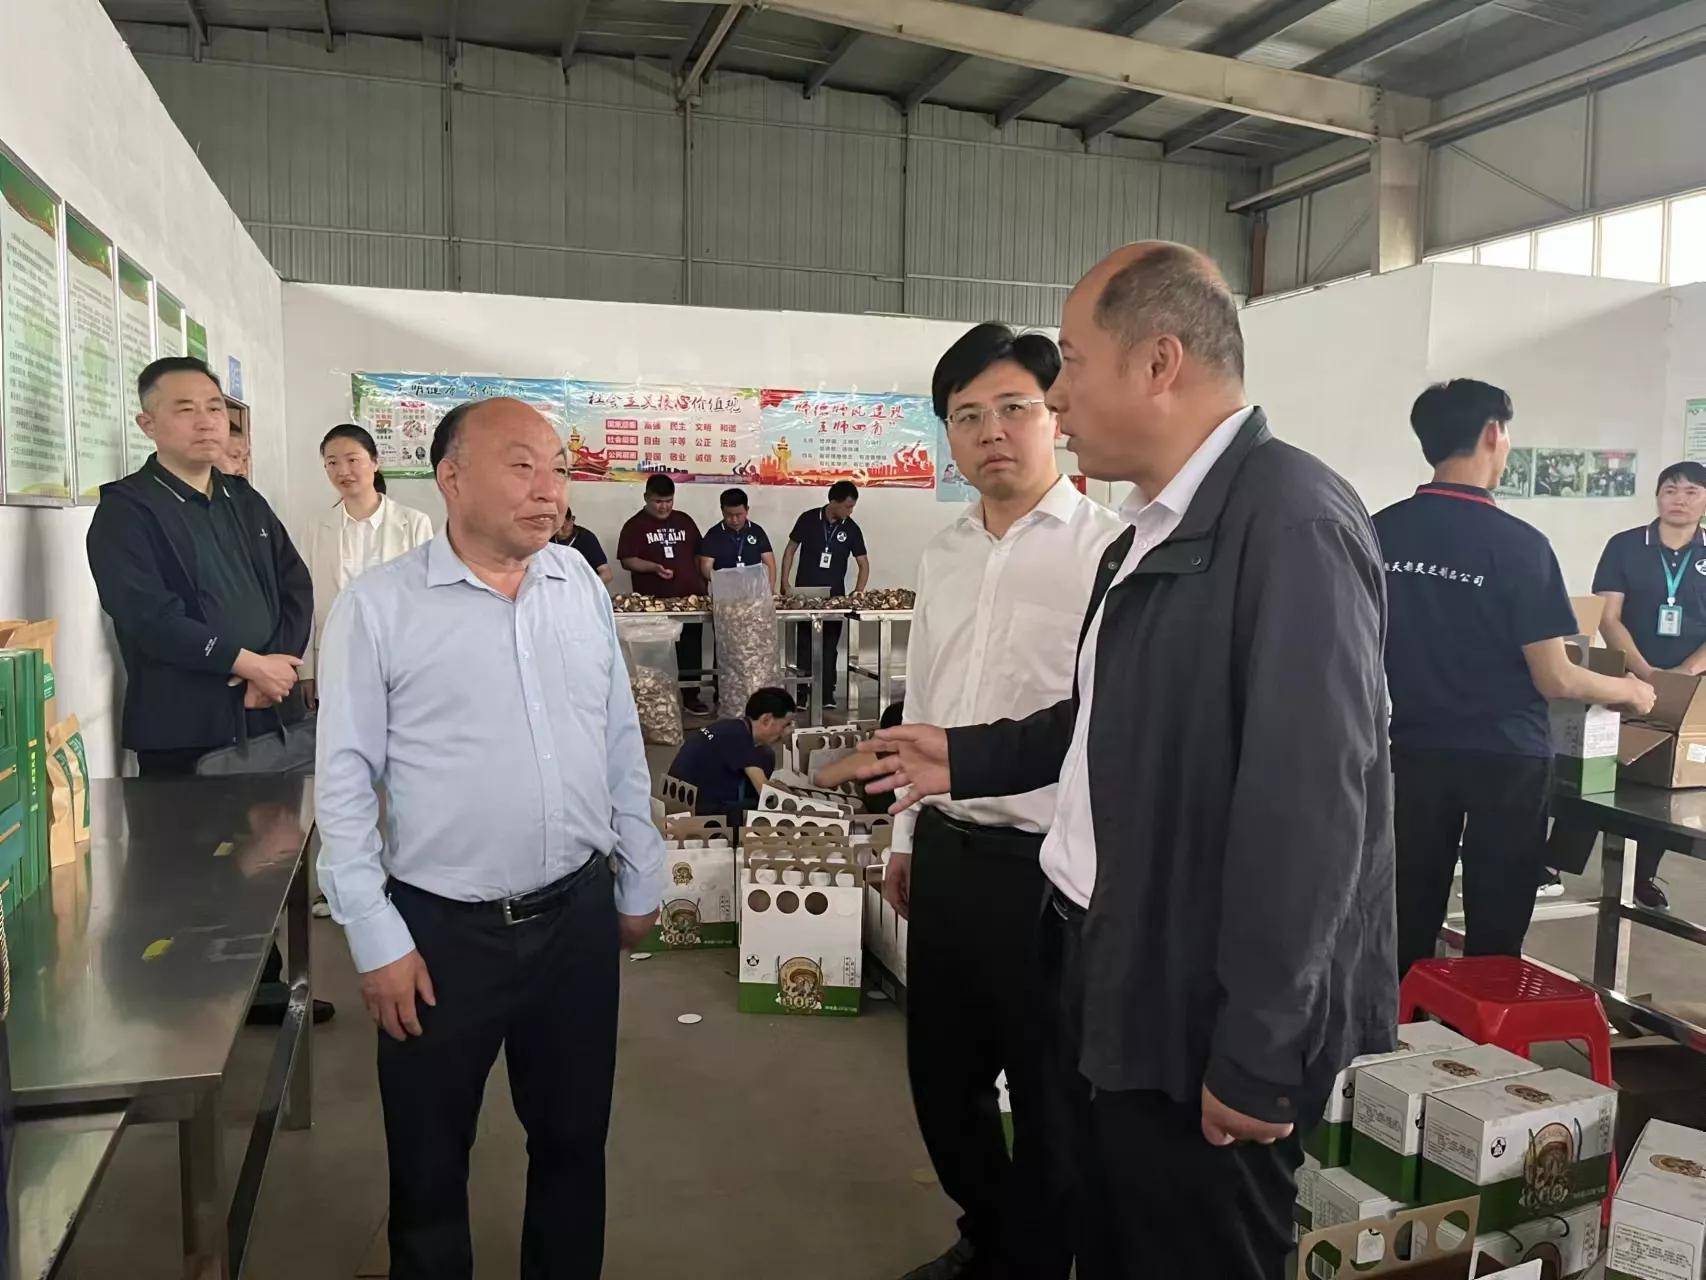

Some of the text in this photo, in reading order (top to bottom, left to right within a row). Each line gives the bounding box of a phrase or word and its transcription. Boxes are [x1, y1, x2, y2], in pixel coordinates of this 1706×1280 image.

[588, 392, 742, 413] 社会主义核心价值观
[644, 437, 660, 445] 自由
[669, 437, 686, 446] 平等
[695, 438, 711, 447] 公正
[720, 439, 736, 447] 法治
